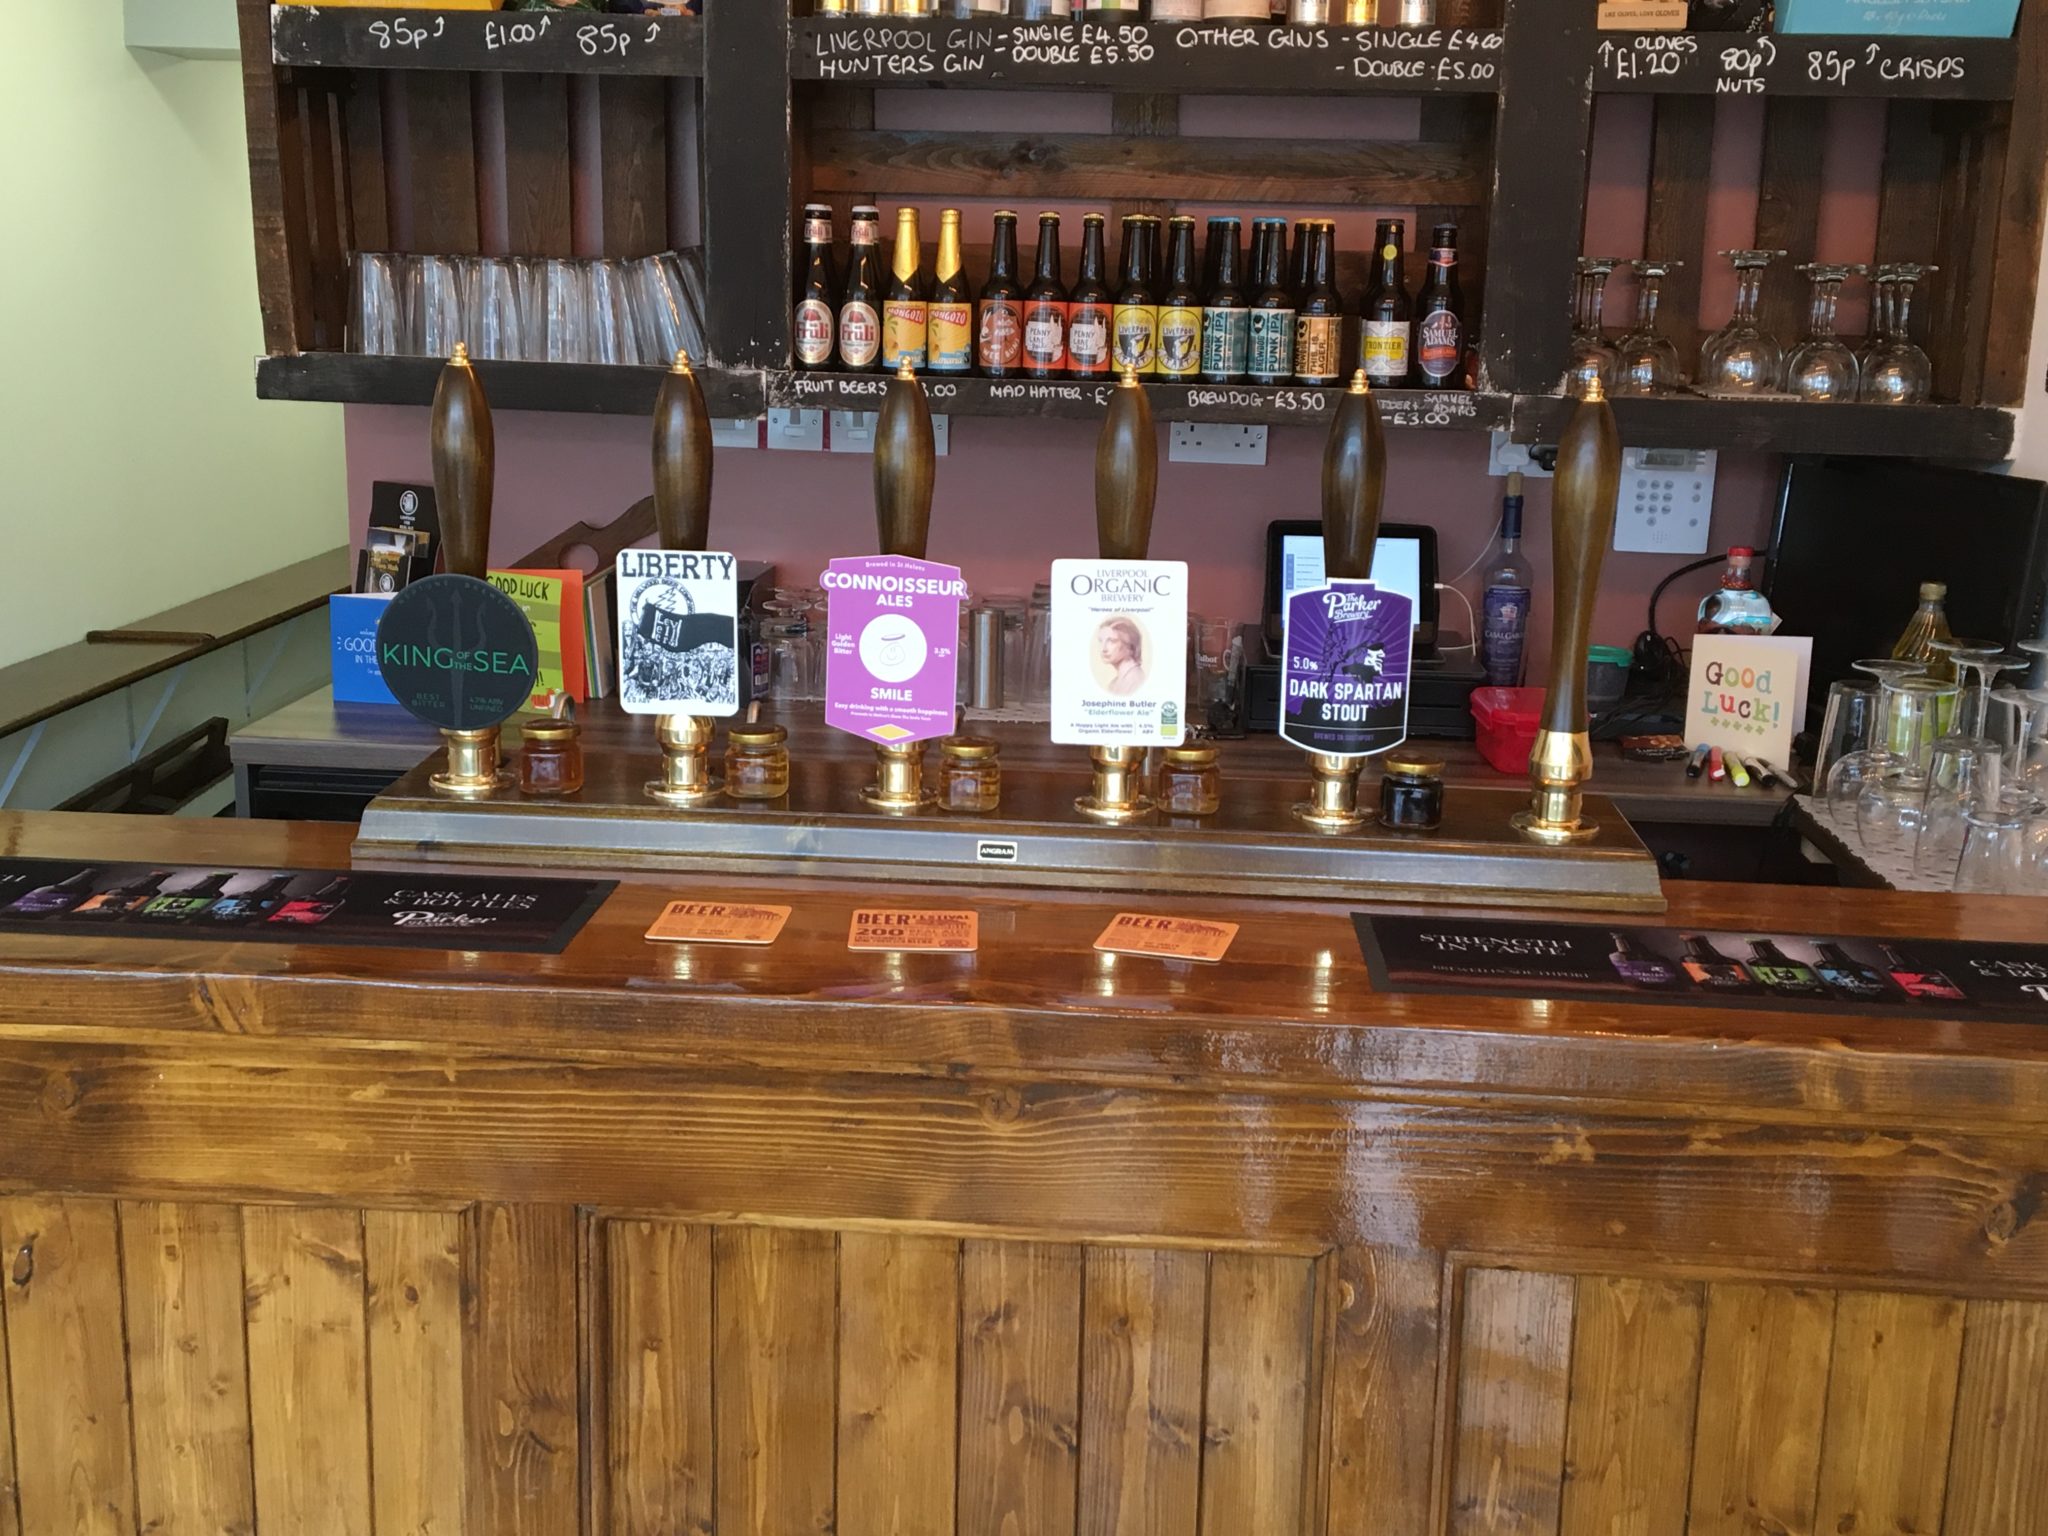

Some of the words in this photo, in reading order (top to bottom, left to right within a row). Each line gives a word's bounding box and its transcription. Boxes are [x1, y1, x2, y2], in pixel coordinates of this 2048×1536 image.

[369, 17, 428, 50] 85p
[485, 22, 536, 49] £1.00
[576, 23, 631, 56] 85p
[816, 27, 936, 56] LIVERPOOL
[946, 27, 993, 50] GIN
[1081, 24, 1149, 45] £4.50
[1176, 28, 1259, 48] OTHER
[1268, 28, 1329, 49] GINS
[1355, 30, 1442, 50] SINGLE
[1634, 35, 1698, 53] OLOVES
[820, 54, 935, 79] HUNTERS
[943, 53, 984, 73] GIN
[1012, 45, 1080, 64] DOUBLE
[1090, 44, 1155, 64] £5.50
[1354, 57, 1424, 77] DOUBLE
[1437, 57, 1494, 80] £5.00
[1617, 48, 1680, 79] £1.20
[1808, 50, 1856, 86] 85p
[1880, 57, 1965, 80] CRISPS
[1716, 77, 1766, 93] NUTS
[796, 321, 829, 339] Früli
[1215, 311, 1224, 332] IPA
[1270, 312, 1280, 333] IPA
[841, 324, 874, 341] Früli
[1030, 327, 1051, 336] PENNY
[1074, 330, 1095, 338] PENNY
[1423, 327, 1458, 338] SAMUEL
[1424, 336, 1456, 347] ADAMS
[1213, 336, 1223, 371] PUNK
[1269, 336, 1279, 372] PUNK
[794, 379, 834, 395] FRUIT
[839, 380, 888, 396] BEERS
[990, 385, 1025, 398] MAD
[1029, 385, 1082, 400] HATTER
[1188, 391, 1263, 407] BREWDOG
[1424, 393, 1473, 405] SAMUEL
[621, 552, 734, 580] LIBERTY
[1097, 569, 1148, 578] LIVERPOOL
[520, 580, 549, 600] LUCK
[823, 572, 965, 596] CONNOISSEUR
[1071, 575, 1171, 596] ORGANIC
[876, 594, 913, 607] ALES
[1101, 594, 1144, 602] BREWERY
[1322, 592, 1381, 618] Parker
[383, 643, 454, 669] KING
[456, 652, 470, 660] OF
[473, 651, 530, 676] SEA
[1293, 656, 1319, 671] 5.0%
[454, 661, 472, 671] THE
[1705, 662, 1772, 694] Good
[870, 687, 913, 701] SMILE
[1290, 679, 1328, 699] DARK
[1334, 682, 1402, 700] SPARTAN
[1081, 700, 1127, 709] Josephine
[1129, 700, 1156, 708] Butler
[1322, 703, 1369, 722] STOUT
[1701, 691, 1780, 728] Luck!
[981, 847, 1014, 855] ANGRAM
[392, 911, 497, 925] Parker
[670, 904, 726, 916] BEER
[857, 913, 911, 925] BEER
[1117, 916, 1172, 929] BEER
[856, 928, 905, 936] 200
[1420, 934, 1573, 949] STRENGTH
